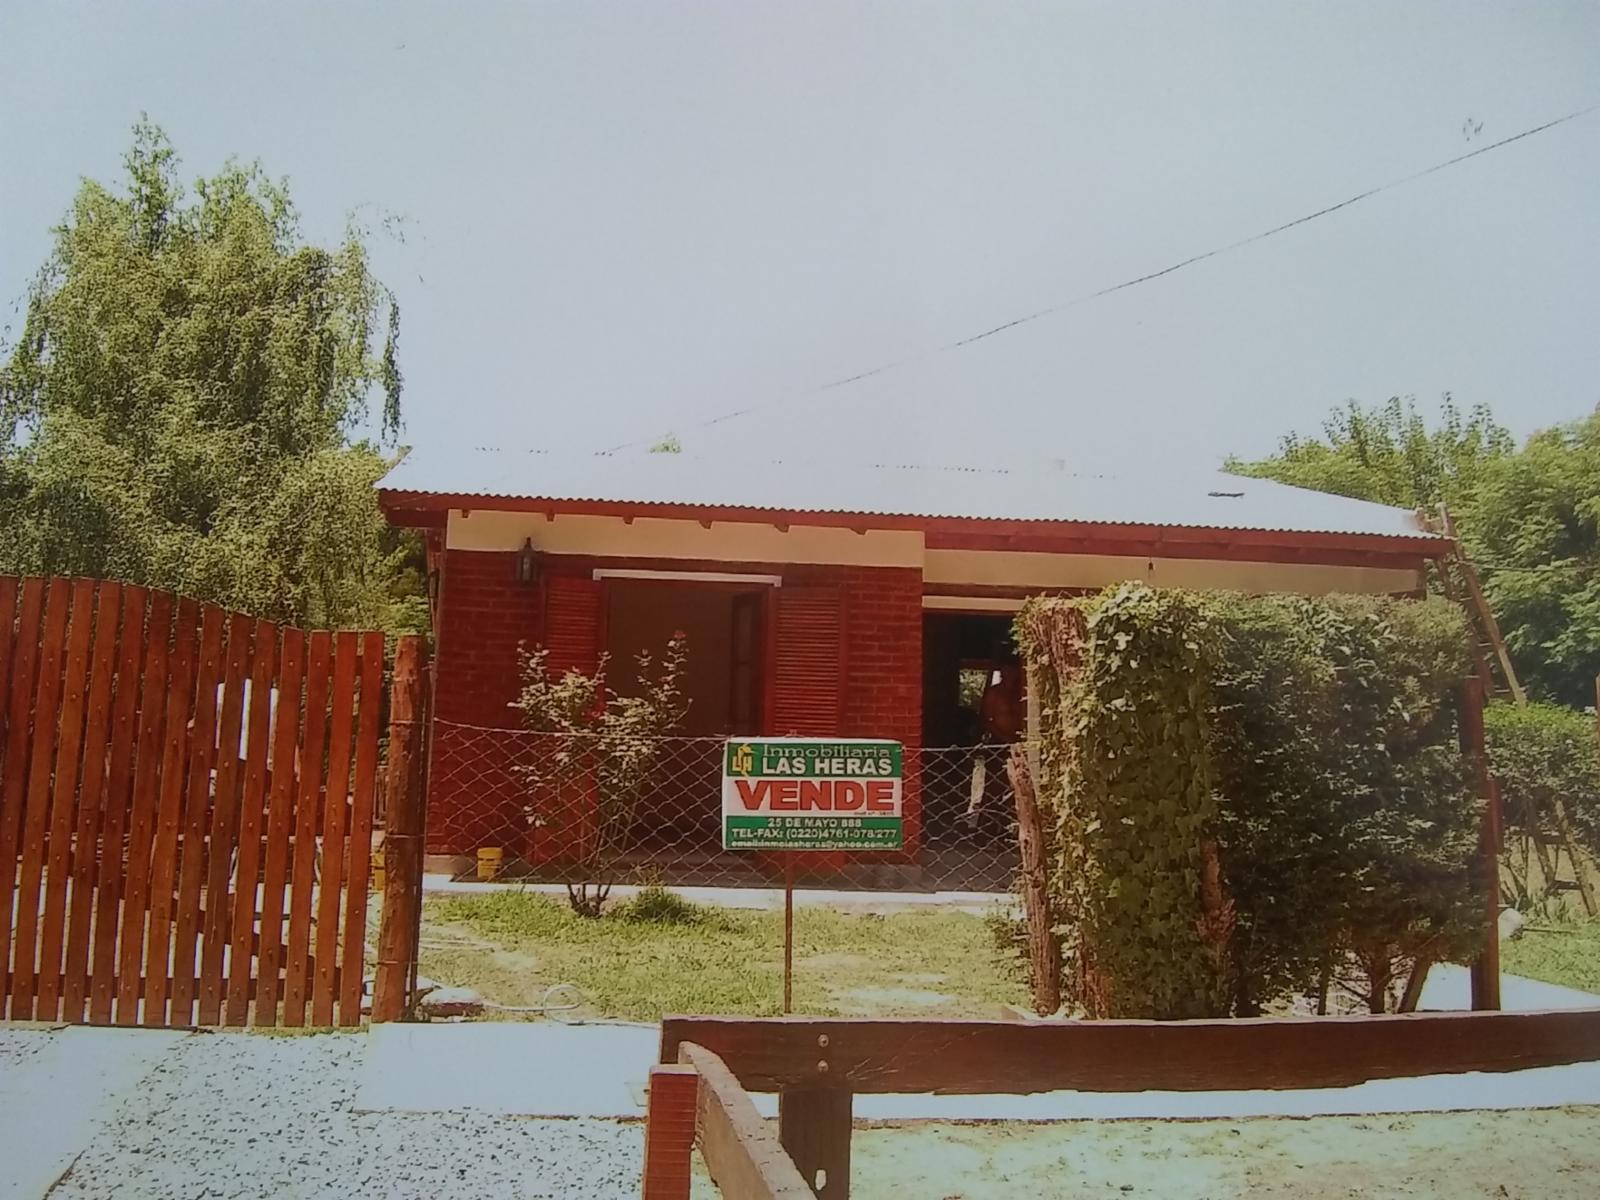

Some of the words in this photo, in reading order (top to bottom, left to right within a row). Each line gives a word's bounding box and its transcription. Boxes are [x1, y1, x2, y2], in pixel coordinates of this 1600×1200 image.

[763, 744, 890, 758] Inmobiliaria
[762, 757, 806, 775] LAS
[814, 758, 893, 775] HERAS
[735, 779, 895, 811] VENDE
[767, 817, 782, 828] 25
[785, 818, 802, 828] DE
[804, 818, 838, 828] MAYO
[731, 828, 783, 838] TEL-FAX:
